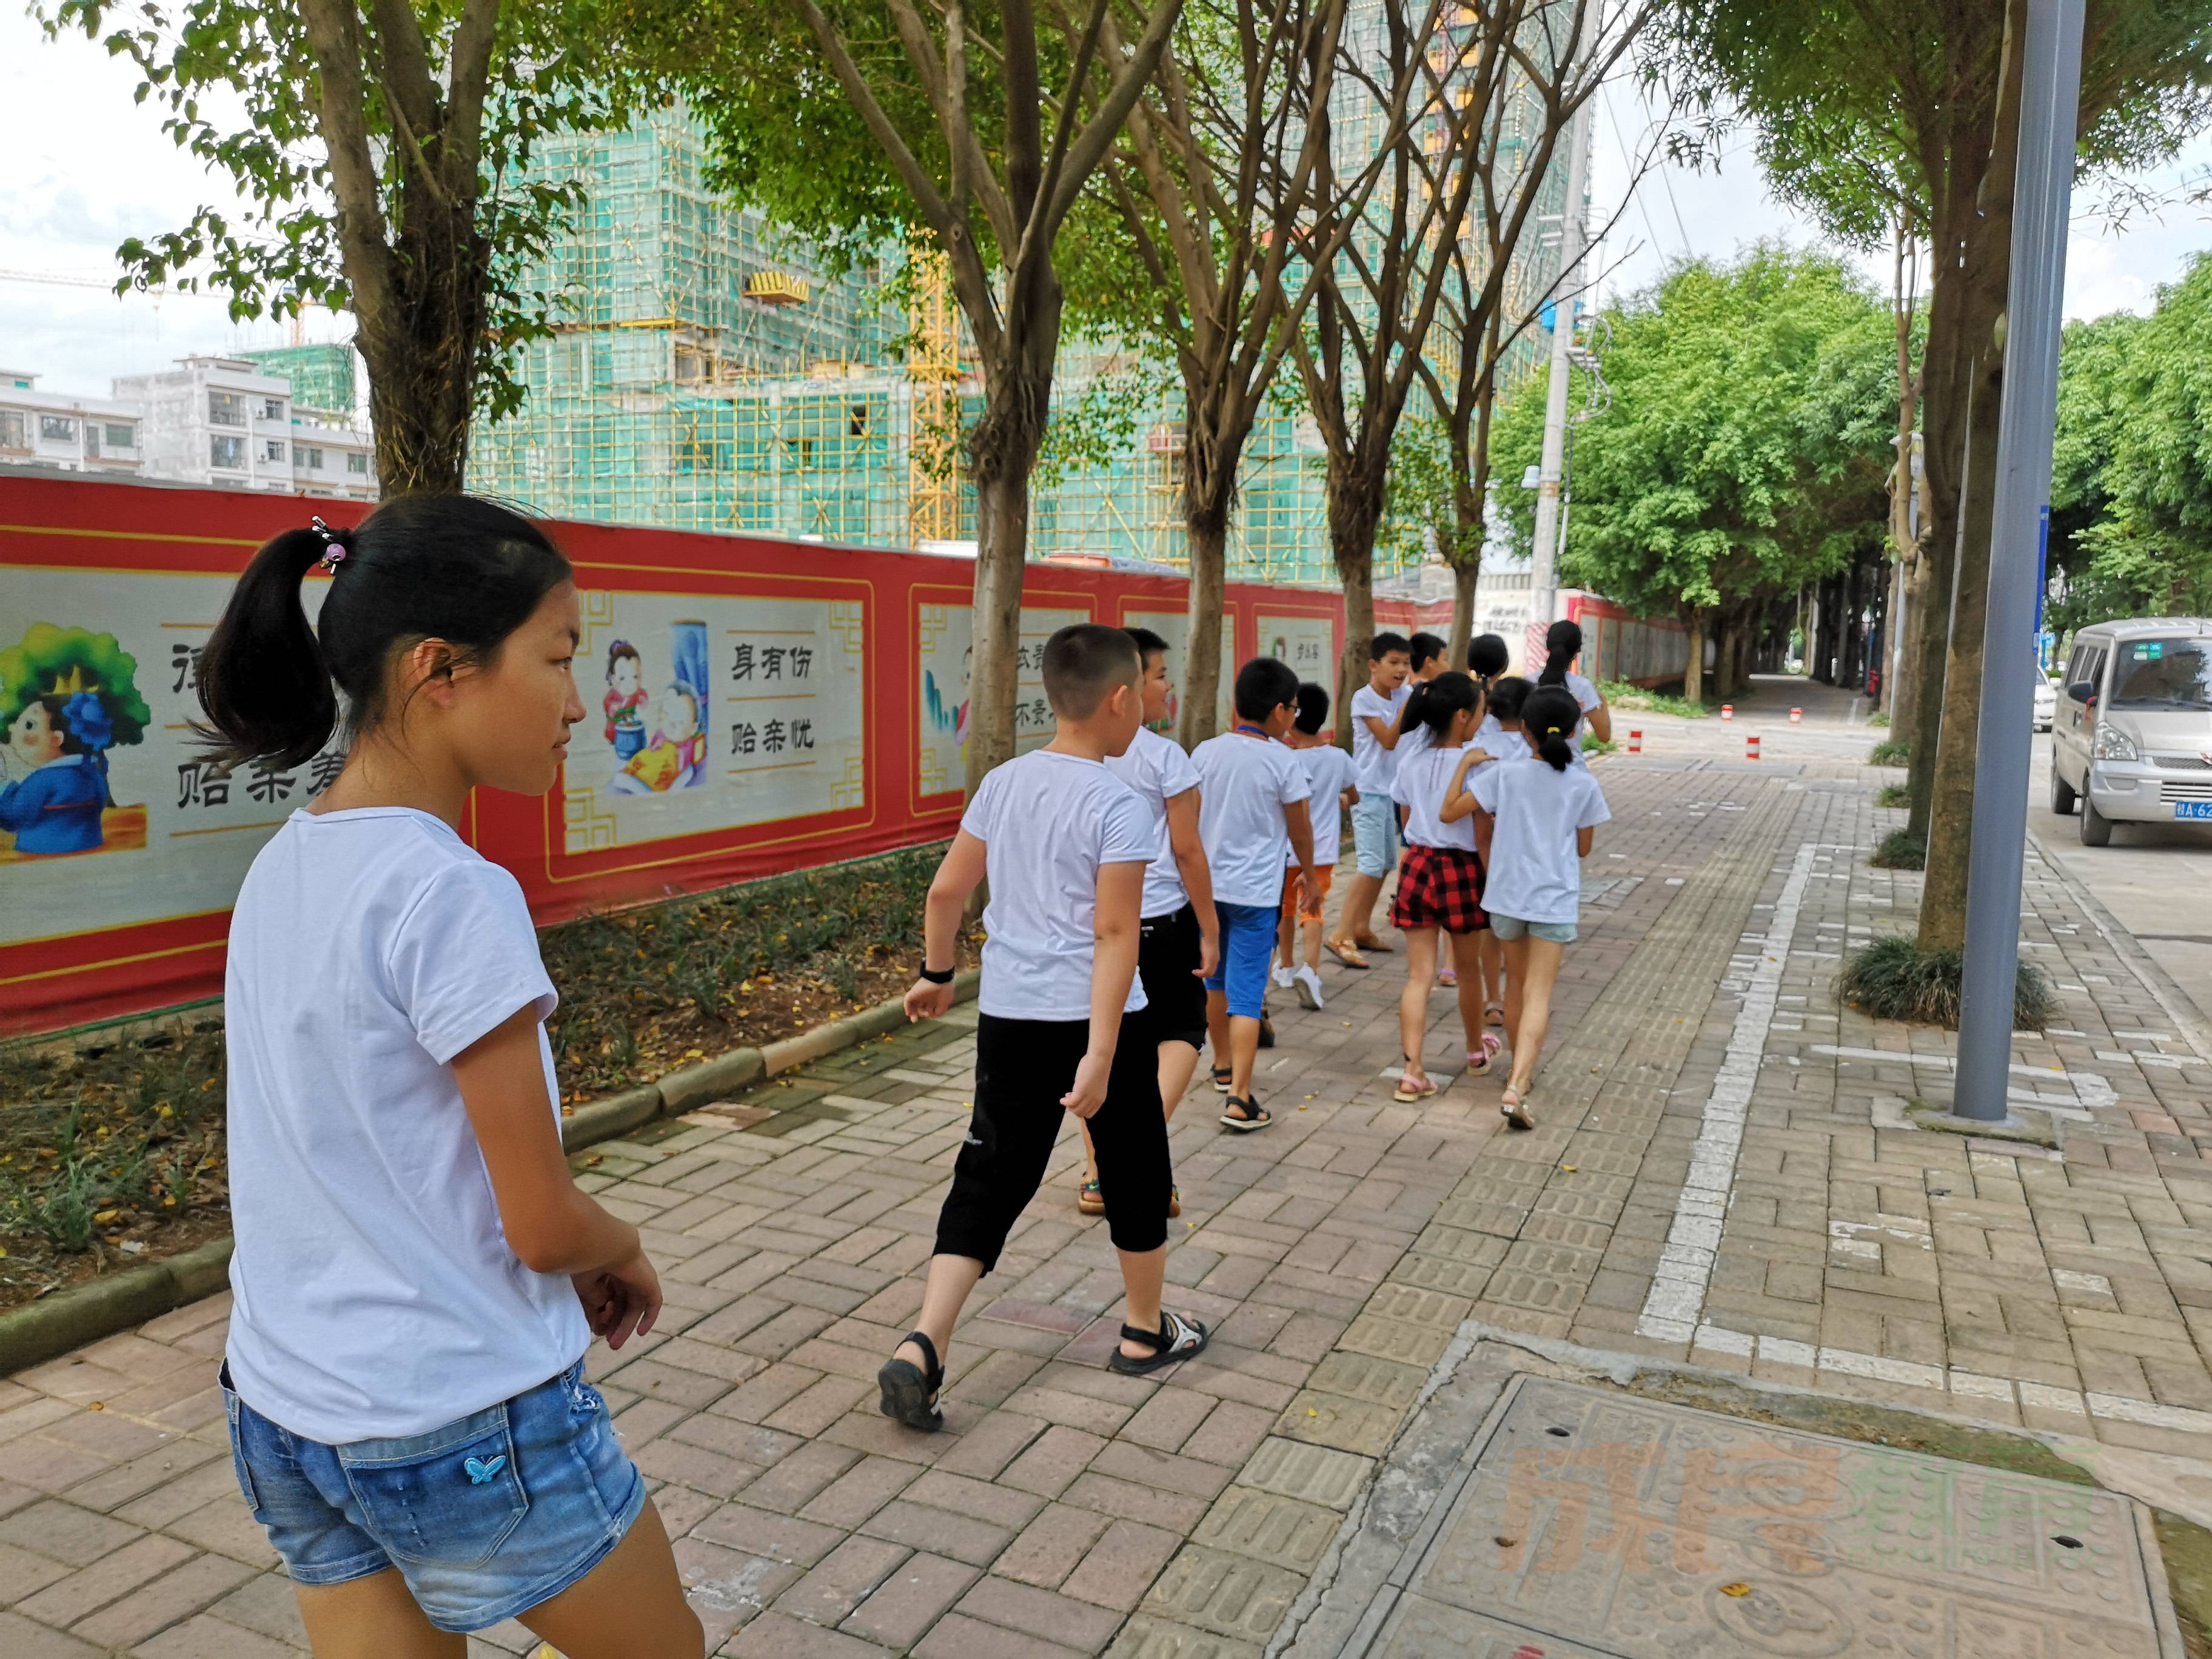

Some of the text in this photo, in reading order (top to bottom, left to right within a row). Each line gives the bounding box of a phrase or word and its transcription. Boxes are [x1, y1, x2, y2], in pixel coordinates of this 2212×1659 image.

[732, 643, 813, 680] 身有伤
[1016, 699, 1054, 726] 不贵
[731, 718, 814, 754] 贻亲忧
